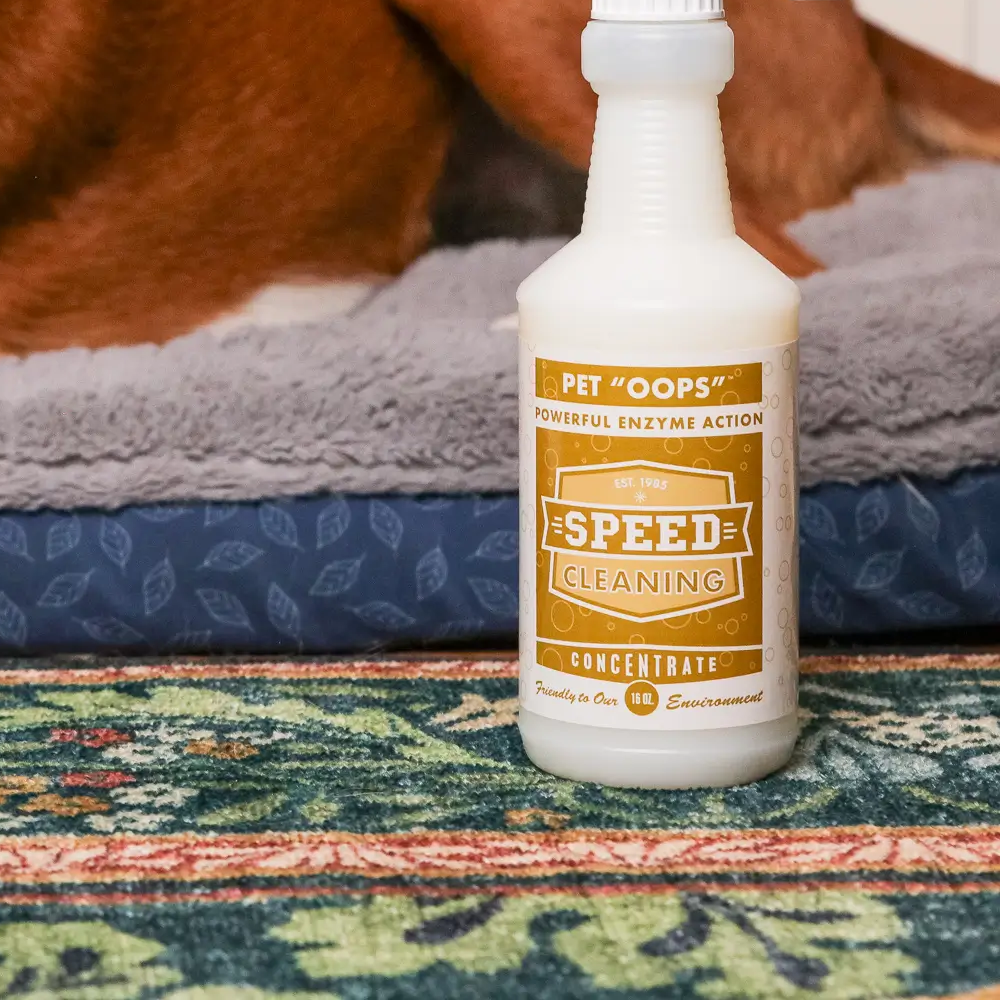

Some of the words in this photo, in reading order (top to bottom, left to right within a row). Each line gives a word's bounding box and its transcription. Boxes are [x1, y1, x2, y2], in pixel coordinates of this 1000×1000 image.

[562, 372, 602, 397] PET
[535, 406, 611, 429] POWERFUL
[618, 417, 695, 430] ENZYME
[702, 412, 764, 429] ACTION
[614, 478, 636, 489] EST.
[640, 477, 668, 490] 1985
[565, 510, 721, 551] SPEED
[562, 563, 726, 595] CLEANING
[571, 651, 717, 678] CONCENTRATE
[535, 680, 576, 704] Friendly
[577, 692, 590, 703] to
[593, 691, 619, 706] Our
[666, 690, 764, 710] Environment
[630, 692, 641, 705] 16
